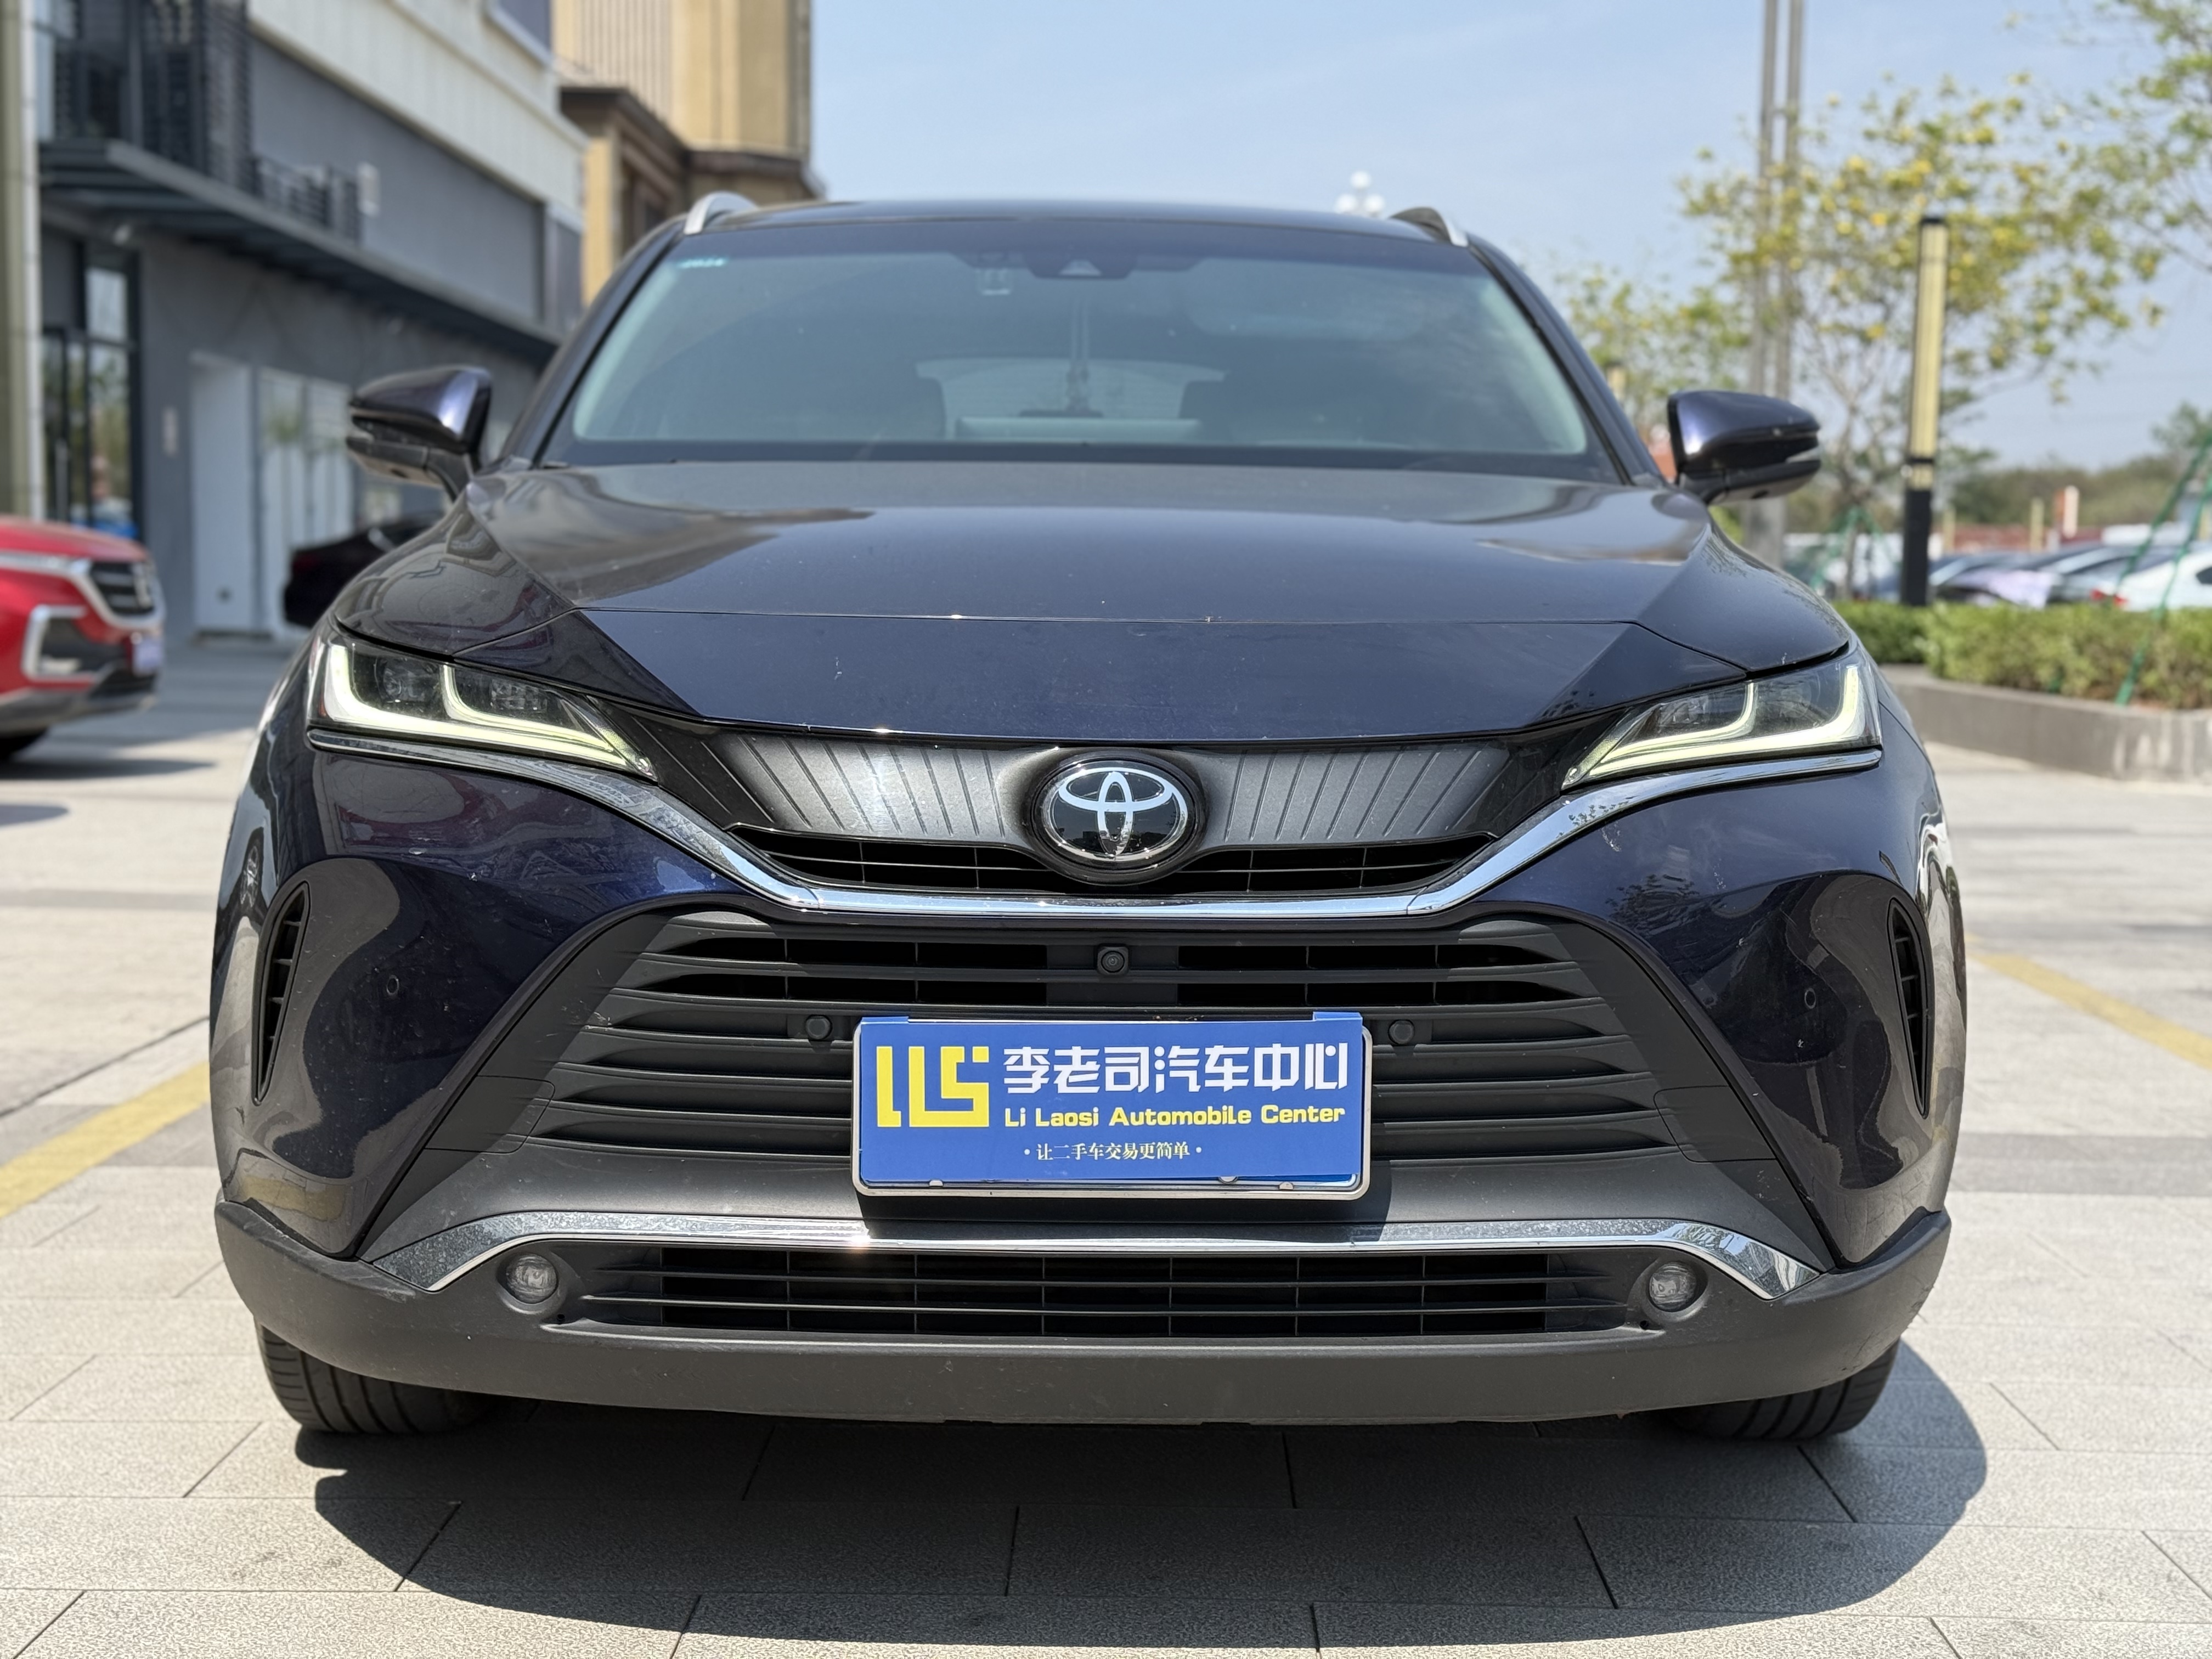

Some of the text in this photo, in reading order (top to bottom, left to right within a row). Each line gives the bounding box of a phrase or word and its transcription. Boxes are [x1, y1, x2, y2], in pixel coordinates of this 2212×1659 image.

[1003, 1042, 1348, 1094] 李老司汽车中心
[1005, 1104, 1346, 1127] Li Laosi Automobile Center
[1036, 1141, 1190, 1161] 让二手车交易更简单
